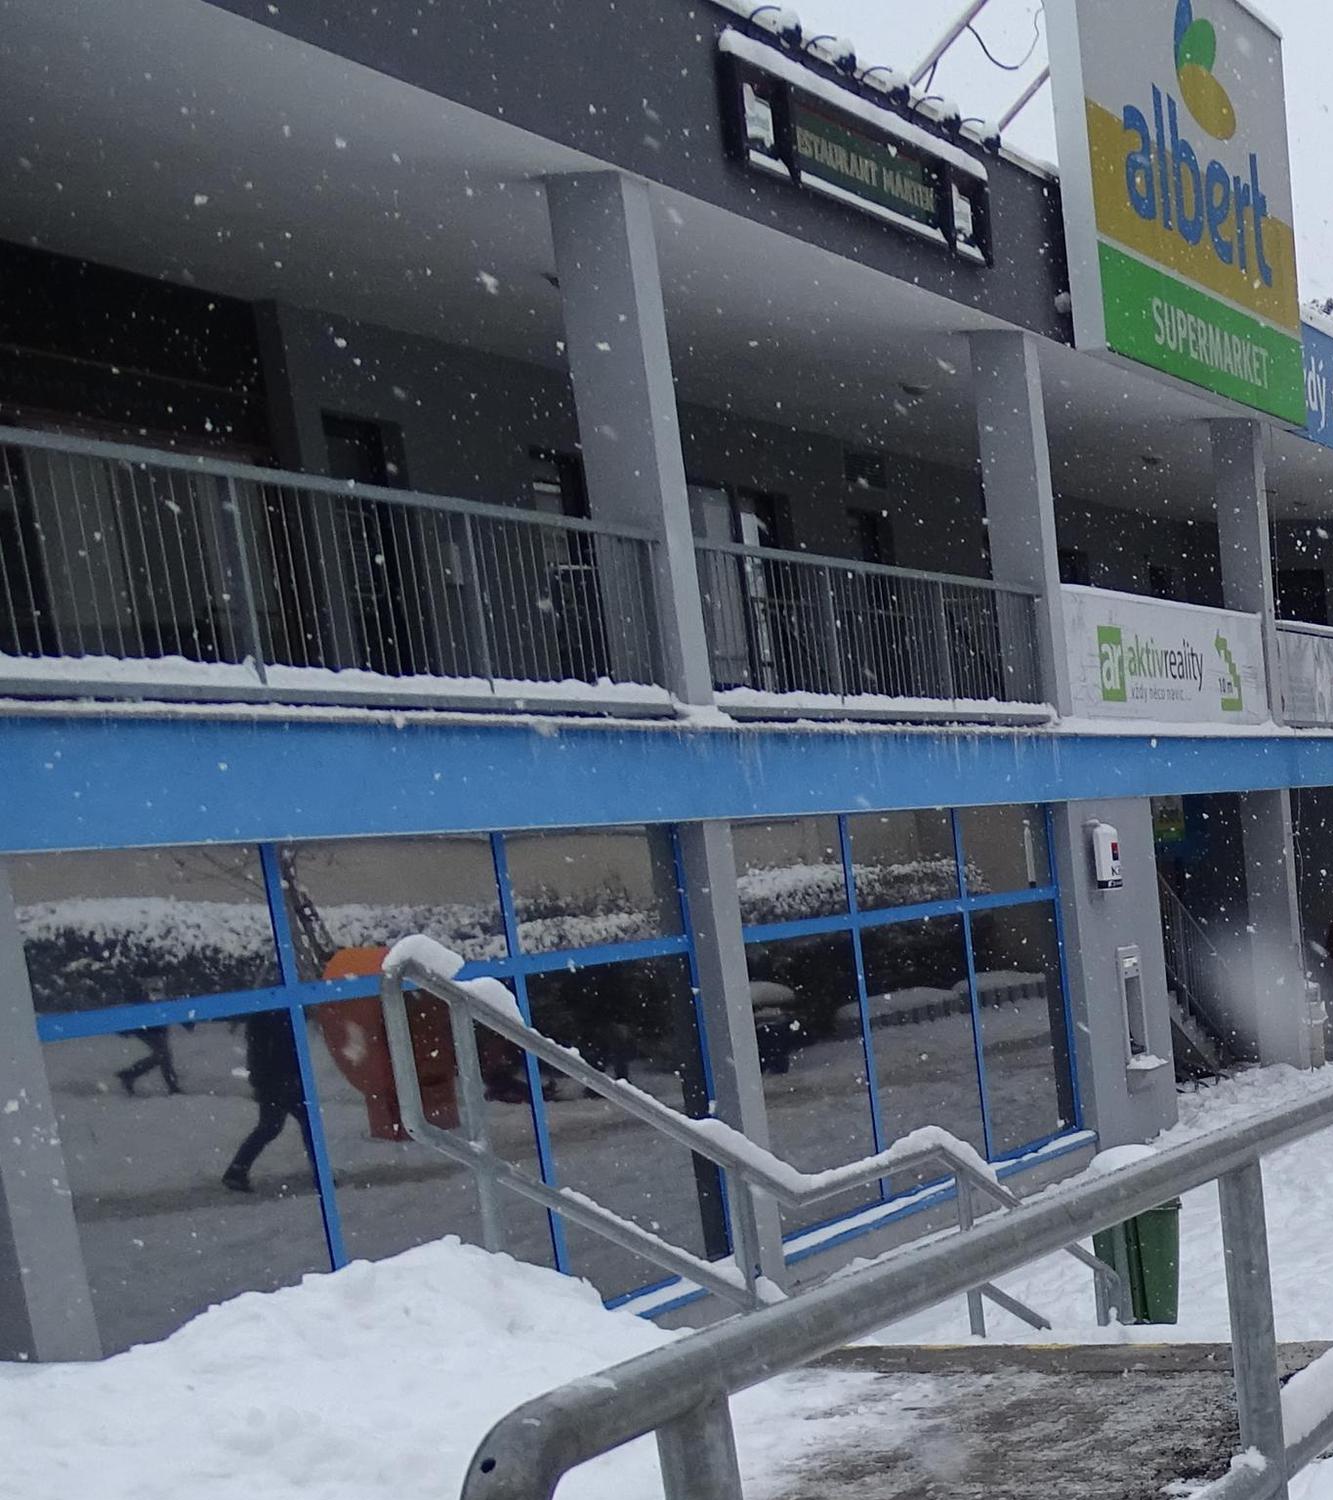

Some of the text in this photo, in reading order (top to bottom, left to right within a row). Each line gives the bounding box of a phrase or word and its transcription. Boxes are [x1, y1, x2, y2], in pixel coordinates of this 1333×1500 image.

[796, 126, 878, 188] ESTAURANT
[1123, 83, 1273, 287] albert
[1152, 297, 1269, 390] SUPERMARKET
[1304, 356, 1326, 432] dý
[1128, 634, 1203, 692] aktivreality
